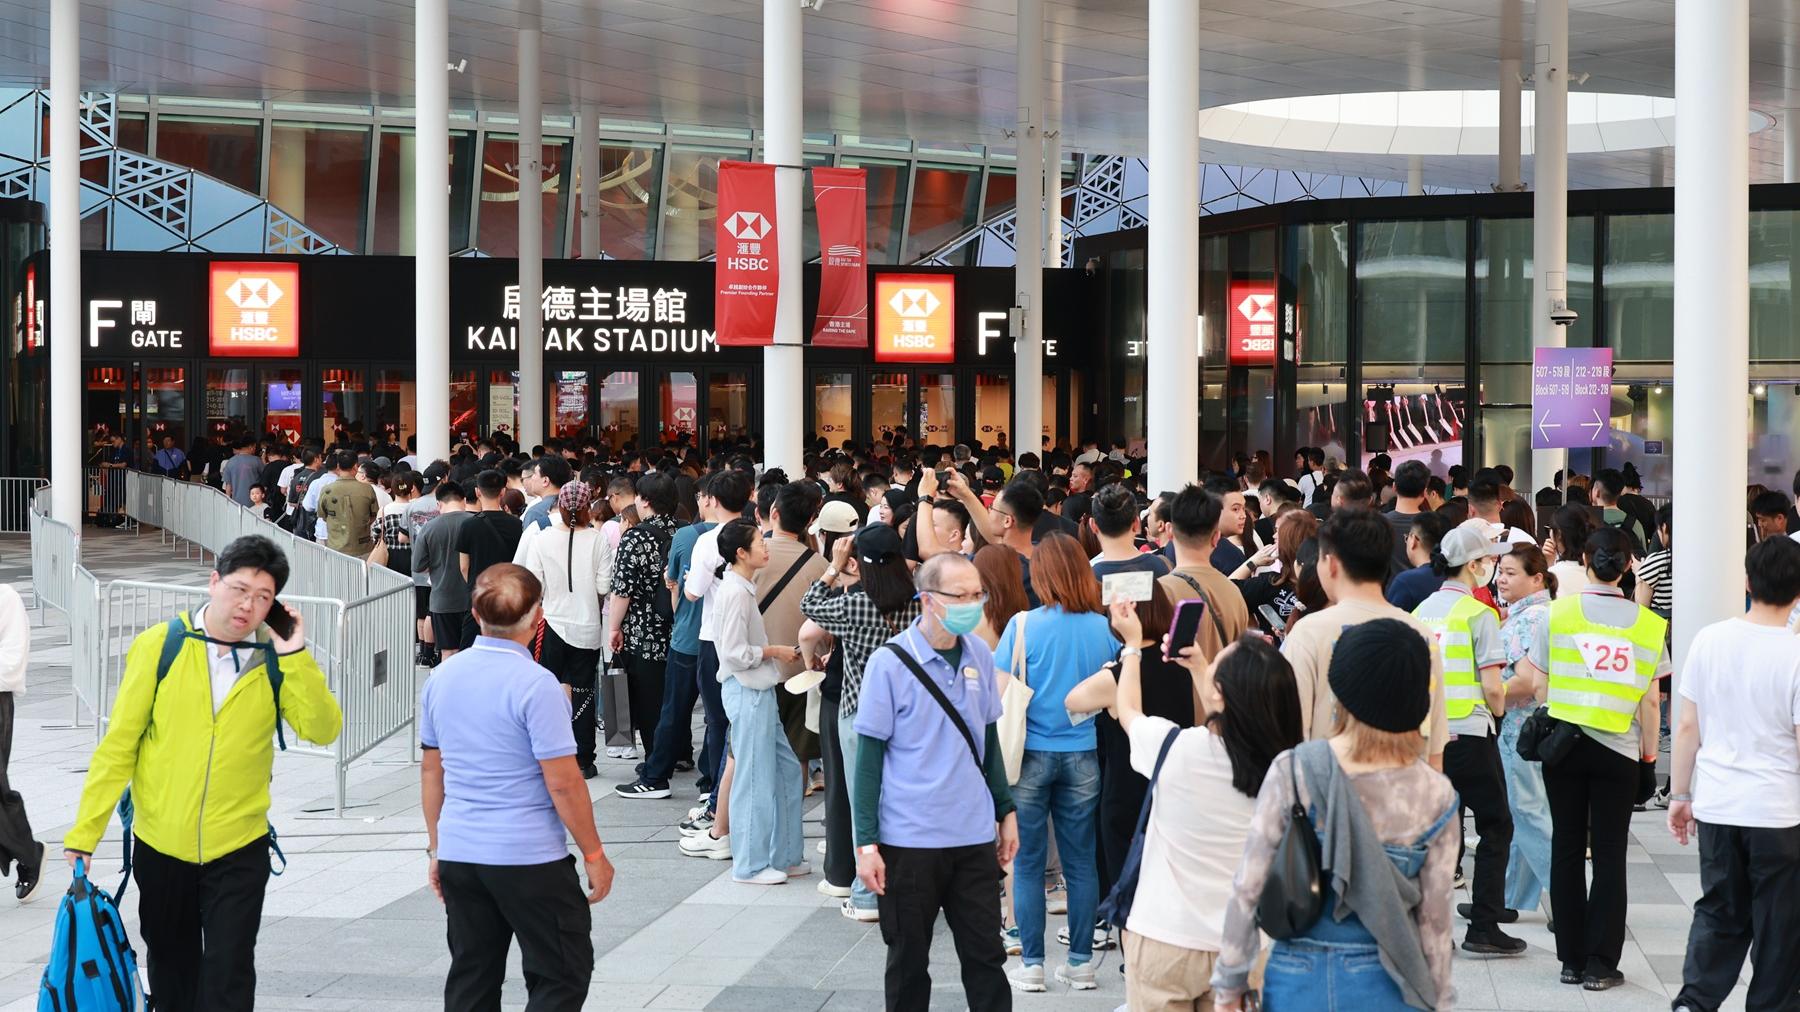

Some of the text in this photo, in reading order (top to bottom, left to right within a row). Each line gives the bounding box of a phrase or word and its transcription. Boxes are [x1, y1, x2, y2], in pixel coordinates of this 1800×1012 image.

[728, 257, 769, 271] HSBC
[131, 300, 156, 326] 閘
[90, 300, 123, 347] F
[131, 330, 183, 348] GATE
[230, 326, 279, 341] HSBC
[467, 326, 720, 352] KAI AK STADIUM
[893, 334, 936, 348] HSBC
[978, 312, 1007, 356] F
[1536, 384, 1549, 395] Block
[1575, 384, 1588, 395] Block
